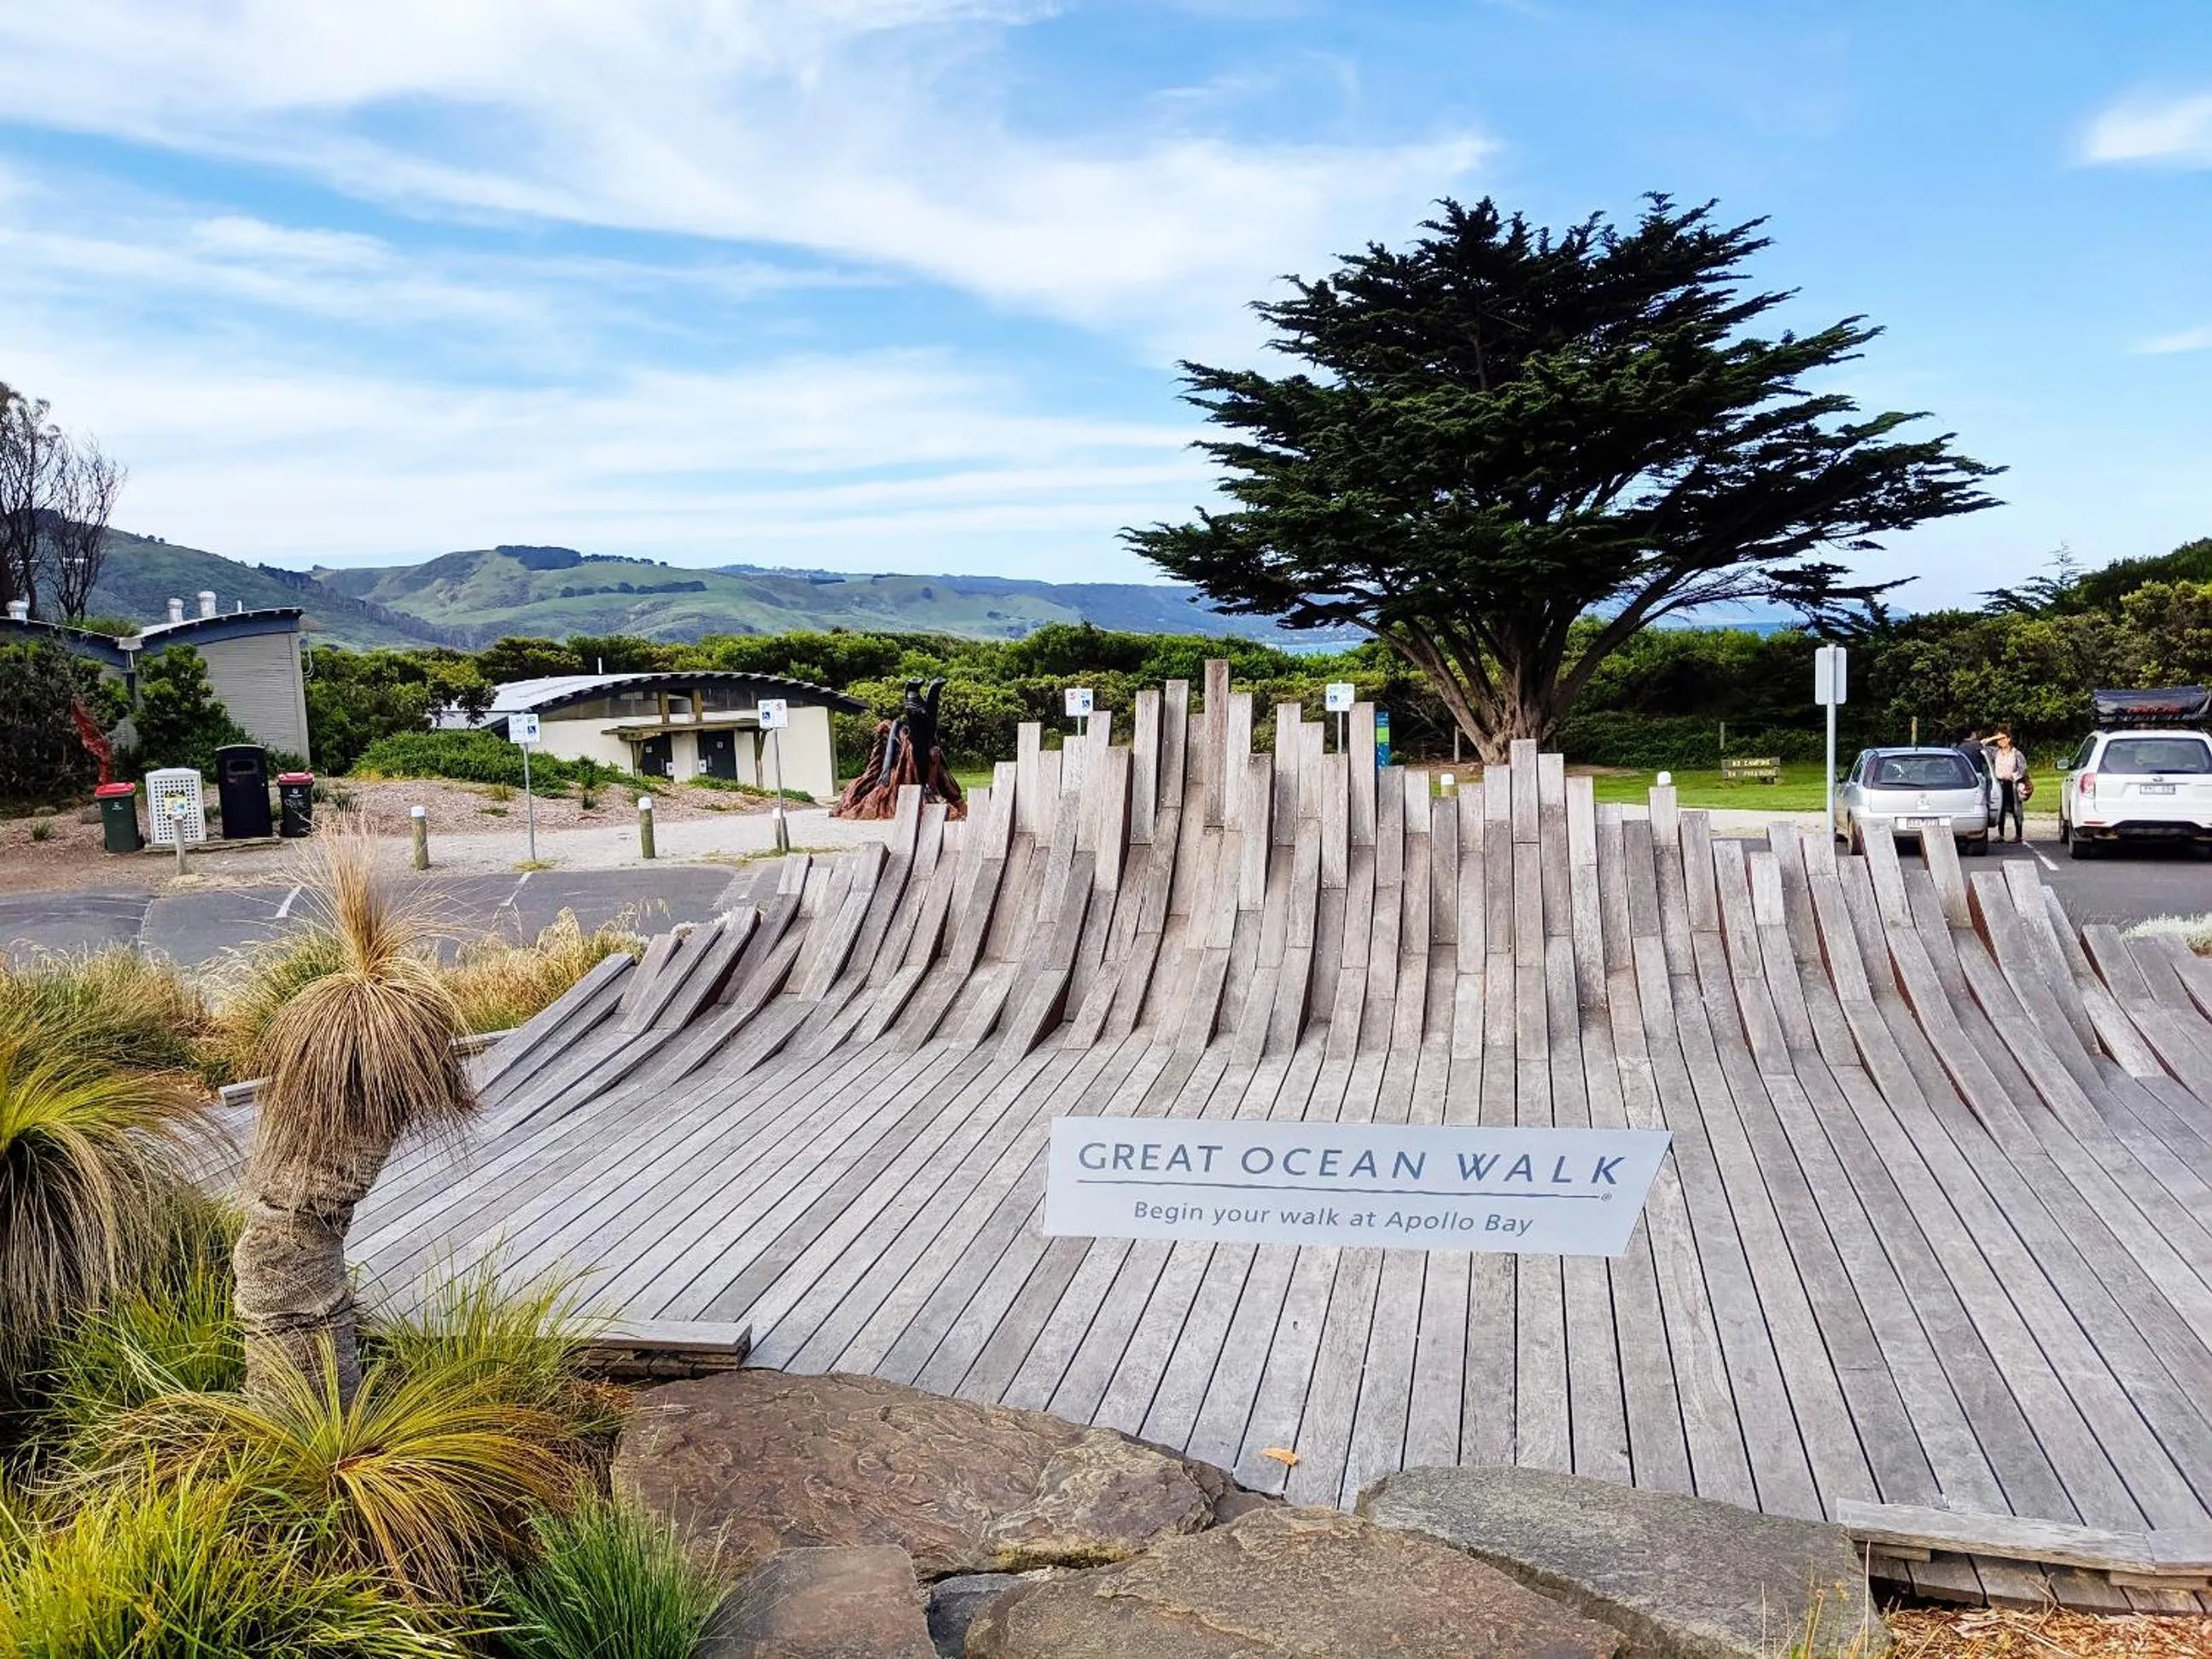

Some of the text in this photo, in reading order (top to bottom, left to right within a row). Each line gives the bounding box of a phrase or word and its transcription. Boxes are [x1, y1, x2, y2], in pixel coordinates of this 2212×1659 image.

[1078, 1142, 1626, 1185] GREAT OCEAN WALK
[1134, 1201, 1534, 1237] Begin your walk at Apollo Bay
